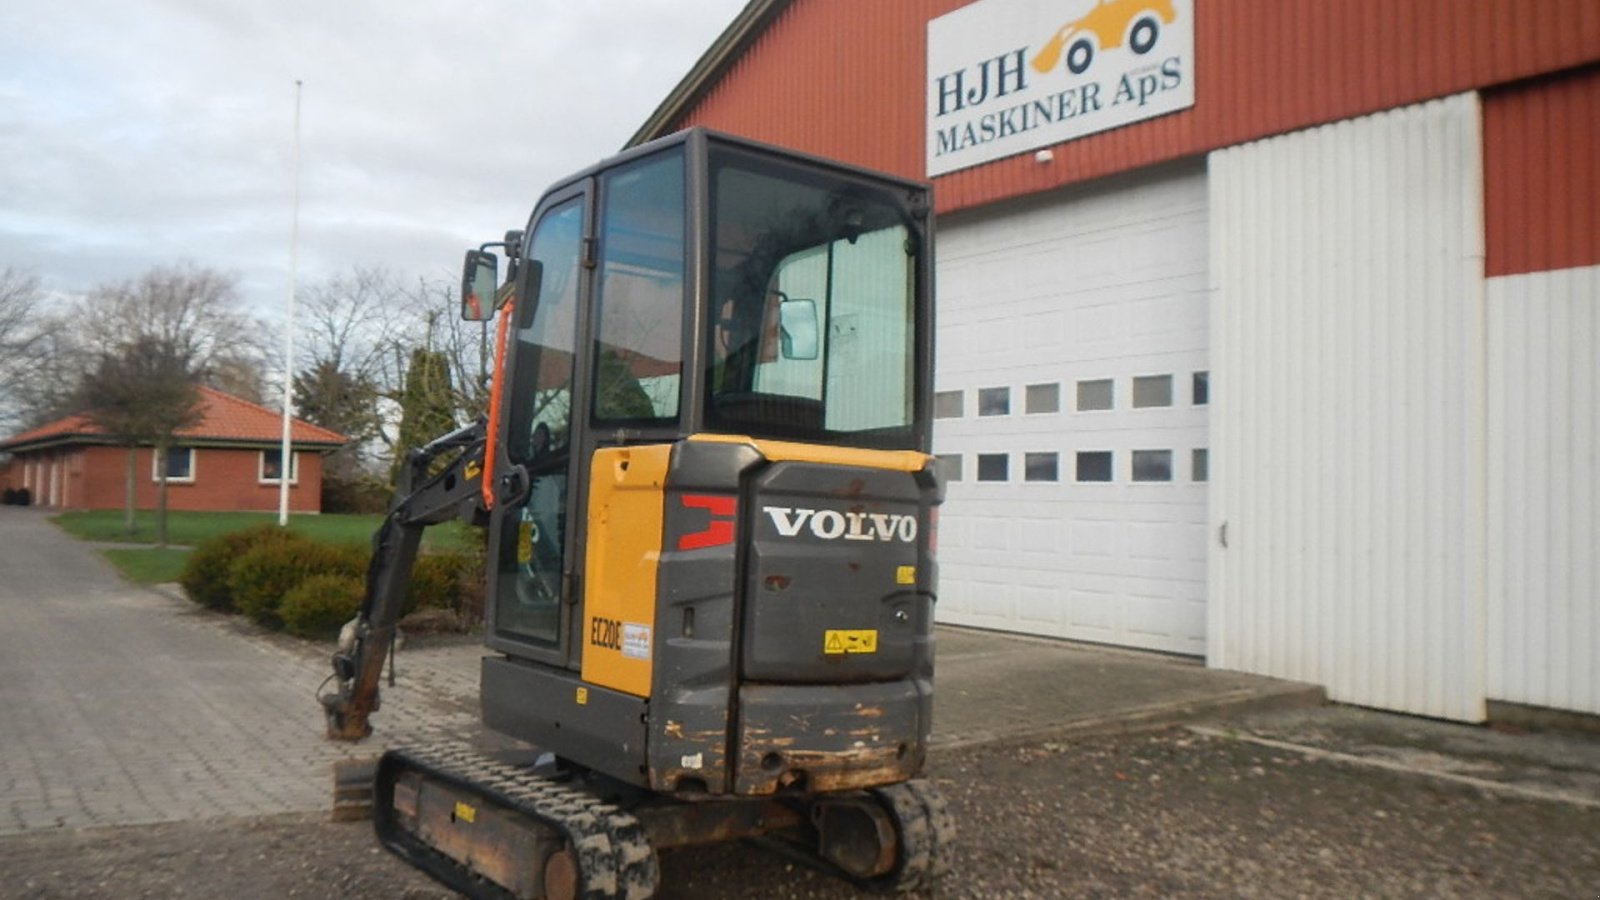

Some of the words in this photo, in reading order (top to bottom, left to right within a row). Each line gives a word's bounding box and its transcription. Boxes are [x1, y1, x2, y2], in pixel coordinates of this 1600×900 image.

[935, 46, 1029, 117] HJH
[935, 82, 1104, 157] MASKINER
[1112, 56, 1182, 107] ApS
[763, 506, 918, 543] VOLVO
